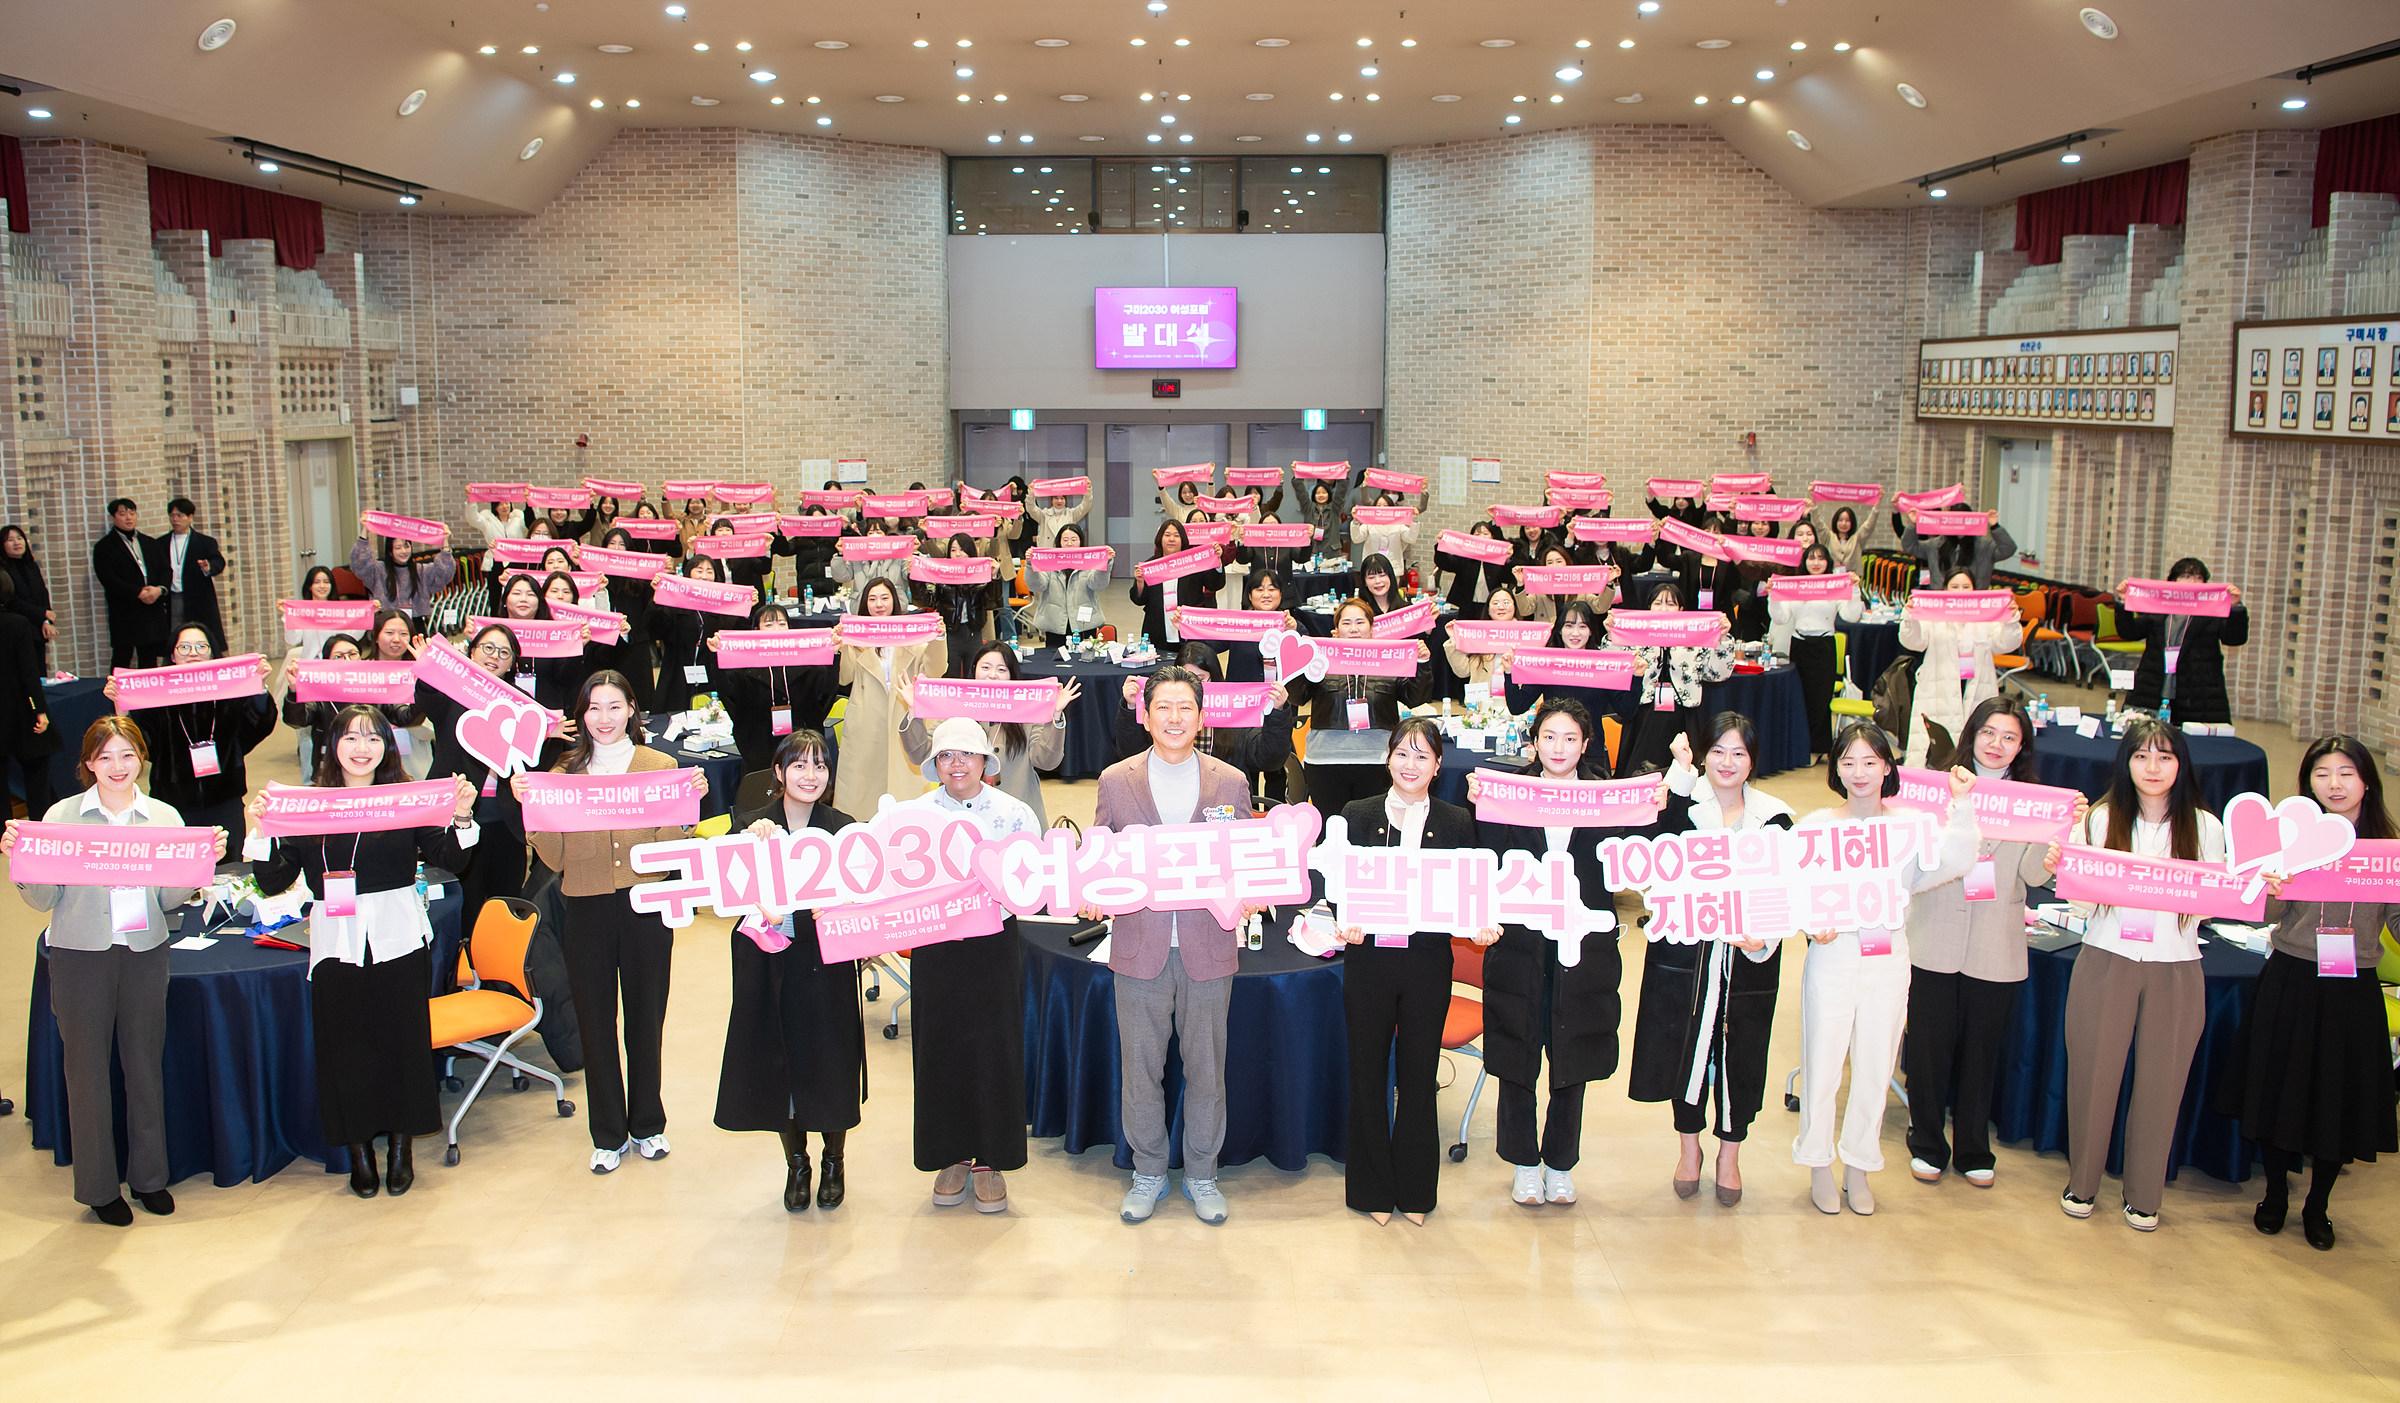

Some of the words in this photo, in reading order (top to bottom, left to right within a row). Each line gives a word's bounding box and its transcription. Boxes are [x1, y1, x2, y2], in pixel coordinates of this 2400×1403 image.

[2345, 327, 2388, 342] 구미시장
[1317, 648, 1339, 657] 혜야
[587, 787, 638, 803] 구미에
[1971, 796, 2007, 814] 미에
[88, 841, 150, 858] 구미에
[640, 819, 983, 918] 구미2030
[1002, 824, 1300, 908] 여성포럼
[1603, 831, 1781, 885] 100명의
[1798, 819, 1940, 872] 지혜가
[1345, 852, 1566, 930] 발대식
[1649, 887, 1791, 938] 지혜를
[1809, 878, 1903, 928] 모아
